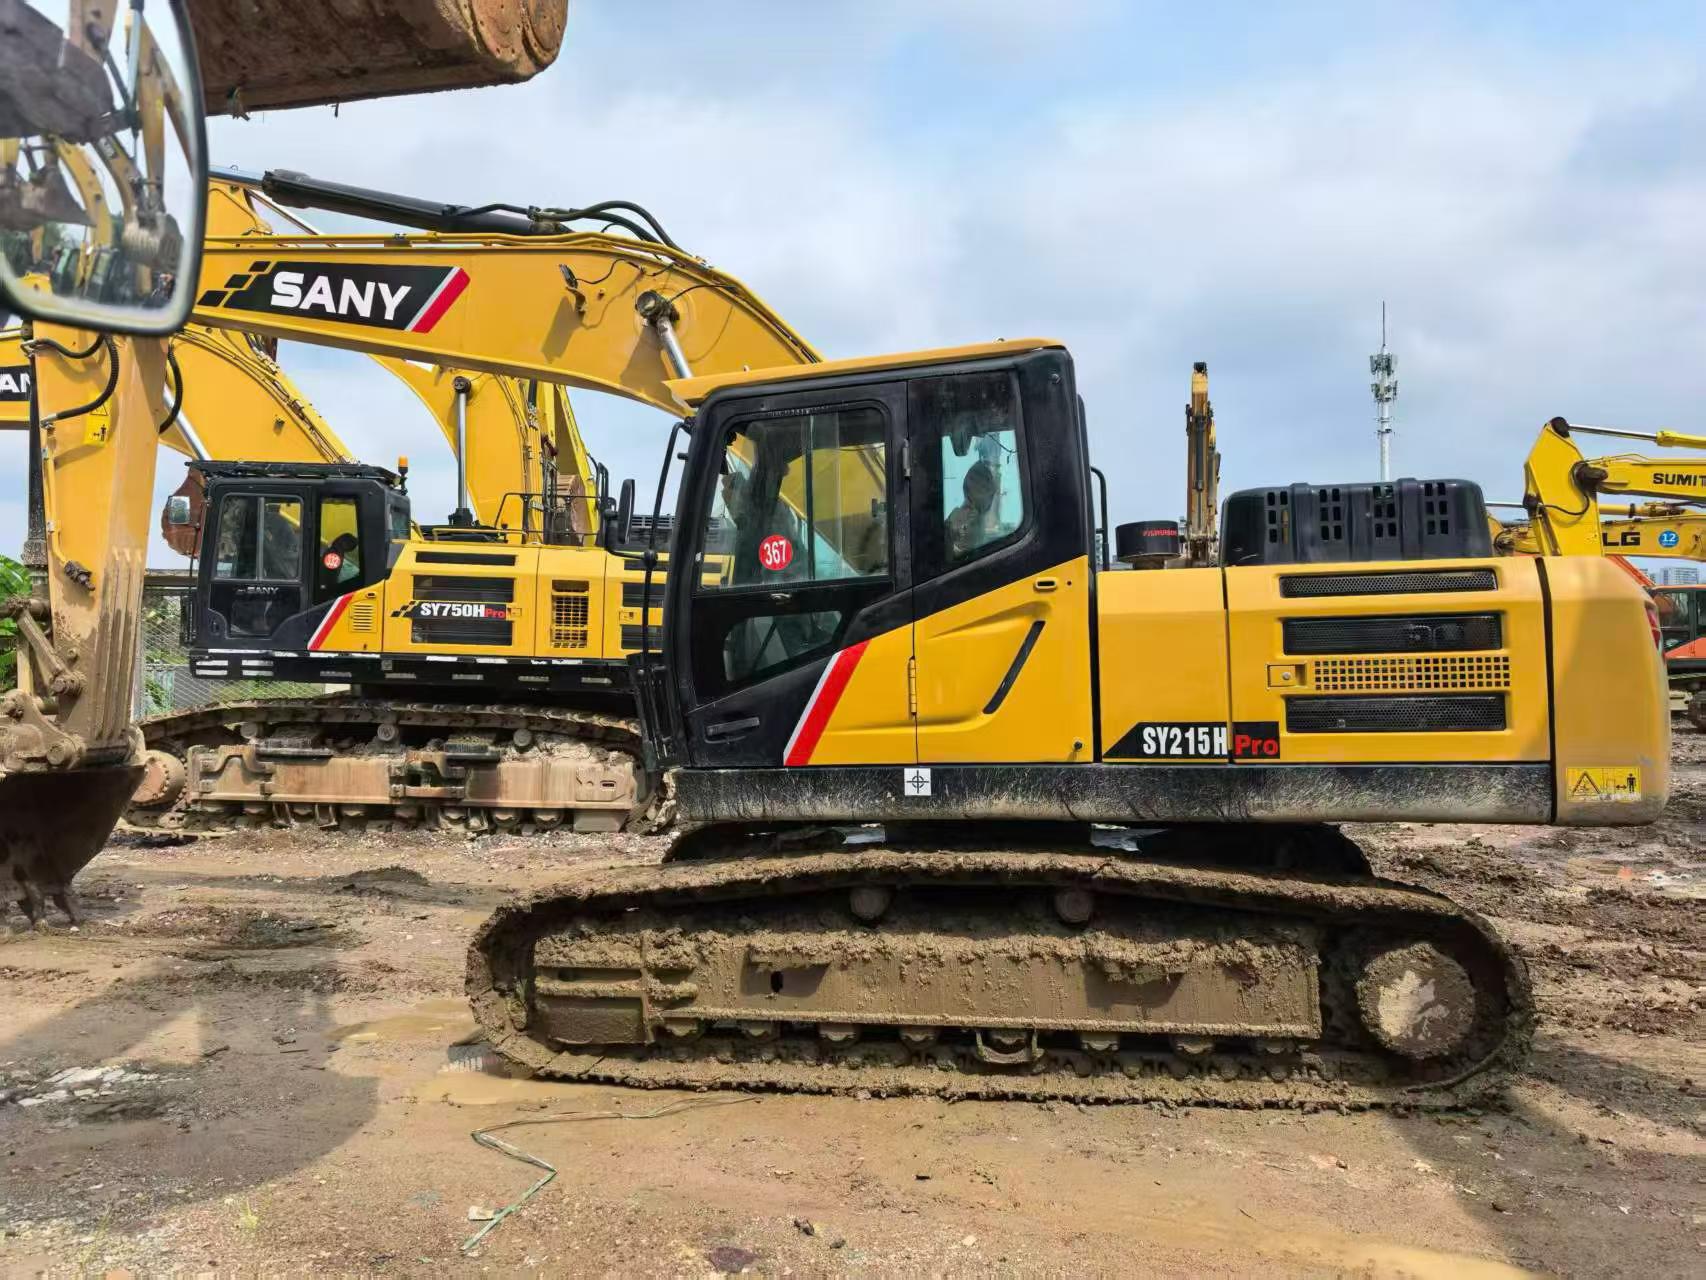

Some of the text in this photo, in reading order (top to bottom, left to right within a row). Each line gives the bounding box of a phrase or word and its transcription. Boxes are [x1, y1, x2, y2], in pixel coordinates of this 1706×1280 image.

[270, 271, 411, 321] SANY
[1662, 533, 1677, 542] 12
[764, 540, 787, 566] 367
[420, 602, 505, 619] SY750H Pro
[1142, 726, 1279, 756] SY215H Pro
